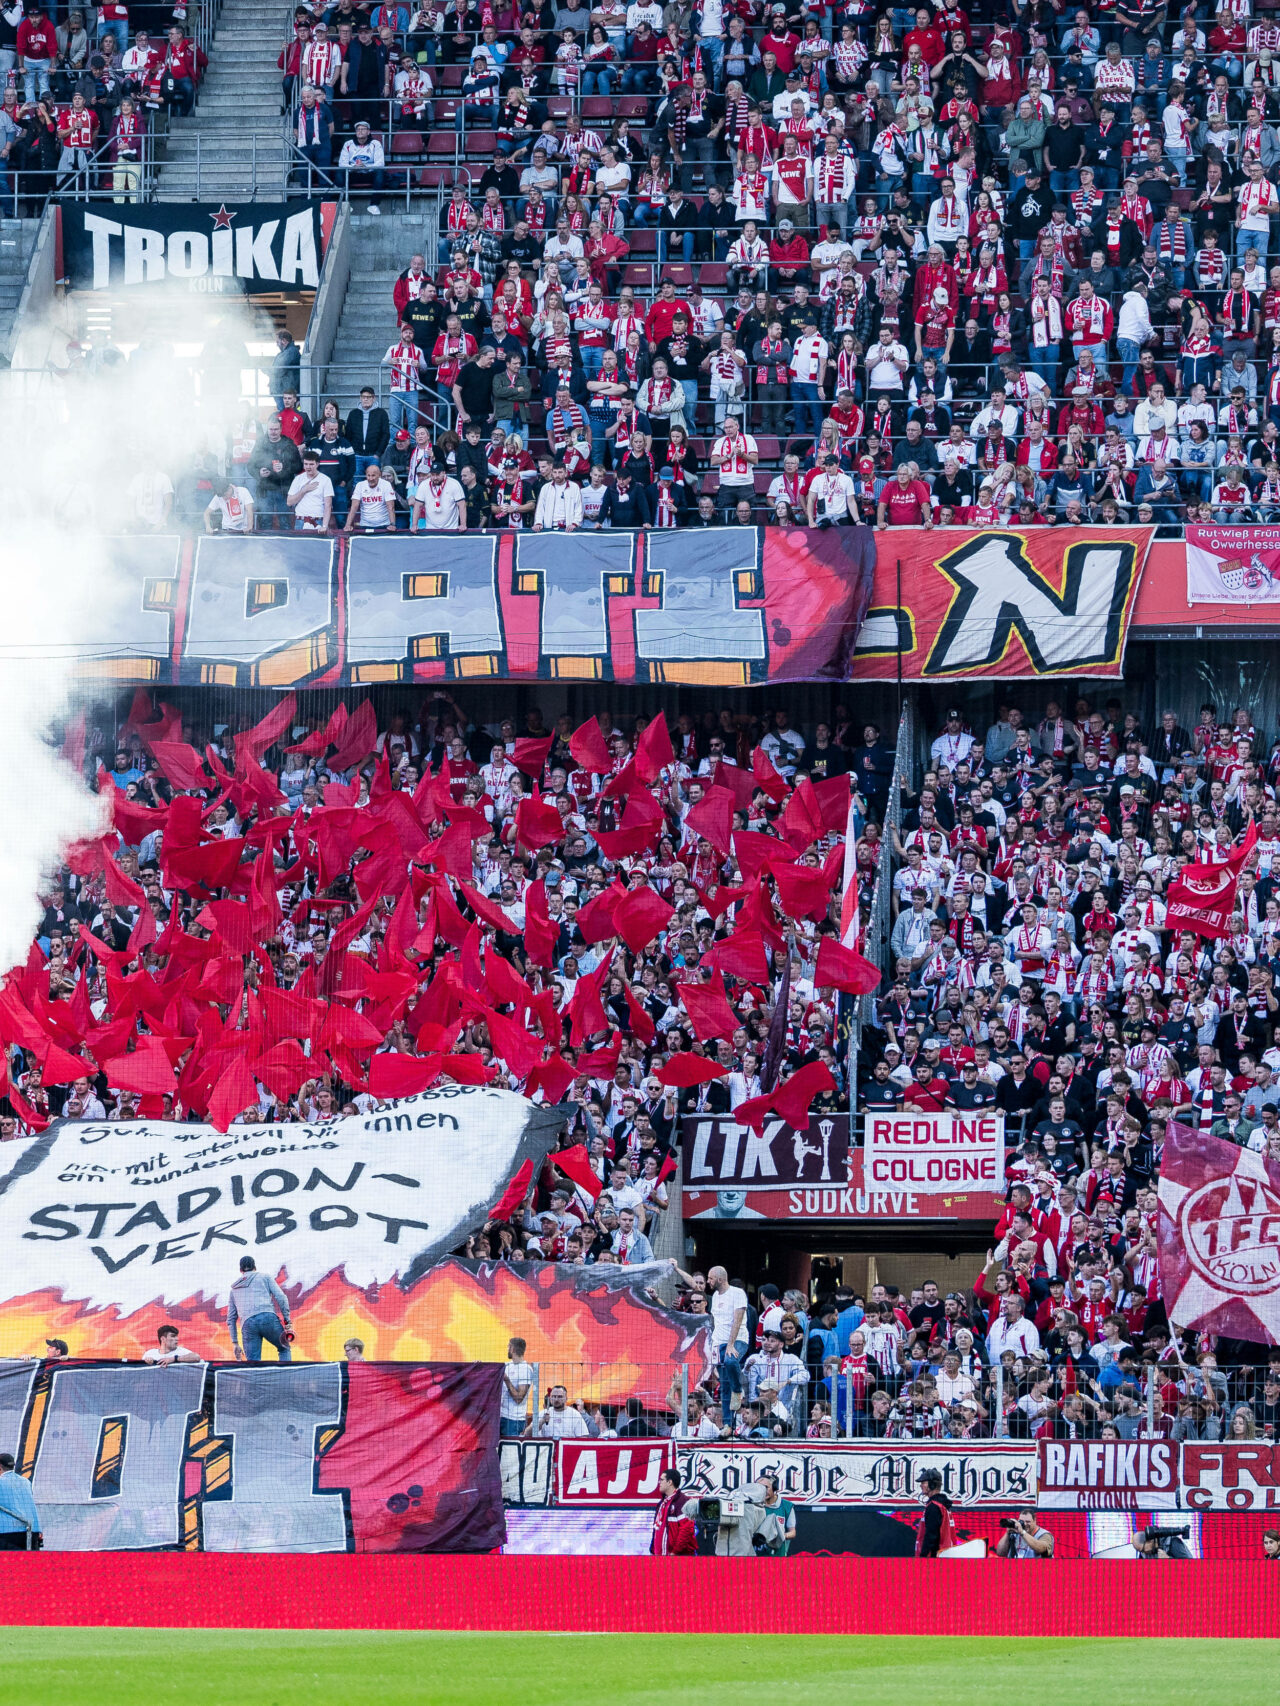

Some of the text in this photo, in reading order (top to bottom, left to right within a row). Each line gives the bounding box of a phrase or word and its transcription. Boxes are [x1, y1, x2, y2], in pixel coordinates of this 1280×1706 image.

[189, 276, 223, 293] KÖLN
[872, 1118, 996, 1145] REDLINE
[690, 1119, 786, 1178] LTK
[57, 1171, 105, 1184] ein
[872, 1156, 996, 1182] COLOGNE
[91, 1204, 429, 1275] VERBOT
[1209, 1254, 1279, 1283] KÖLN
[677, 1452, 1033, 1501] Kölsche Mthos
[1046, 1444, 1171, 1488] RAFIKIS
